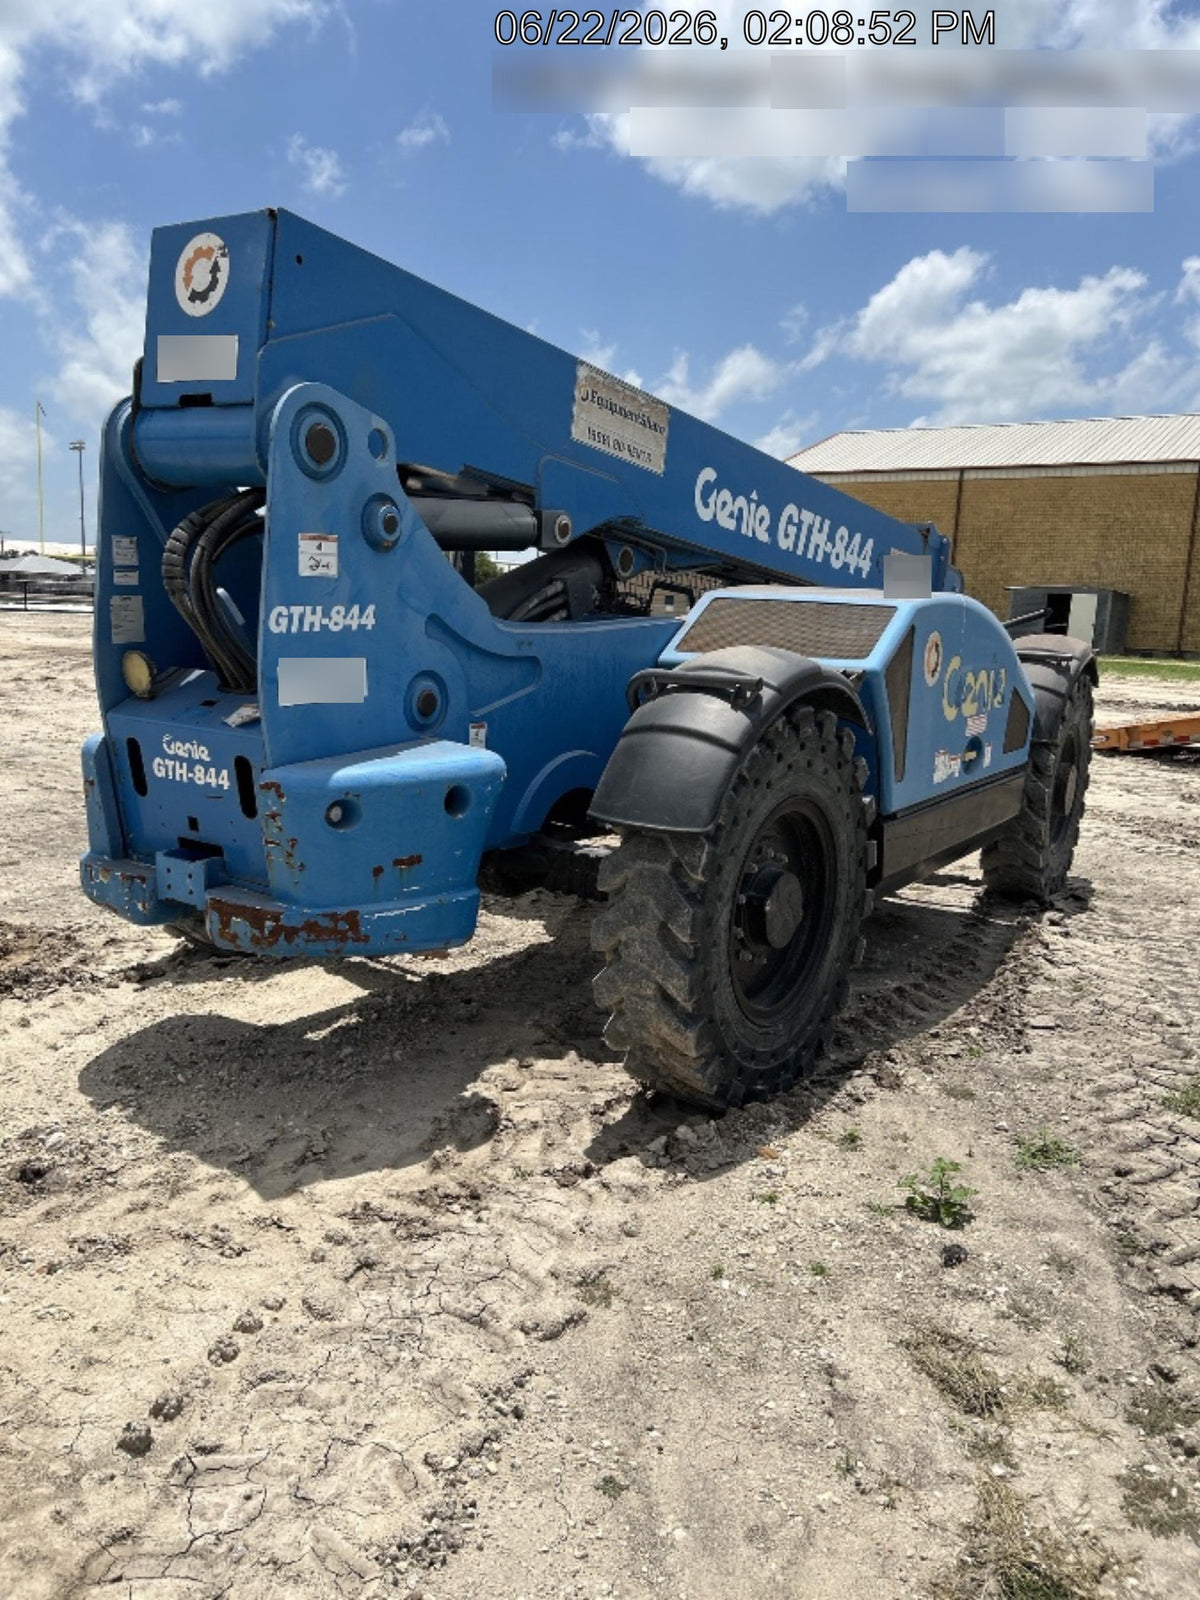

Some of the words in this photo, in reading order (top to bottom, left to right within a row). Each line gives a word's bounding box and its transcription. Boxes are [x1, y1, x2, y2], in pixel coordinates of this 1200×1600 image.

[694, 467, 771, 544] Genie
[777, 503, 875, 579] GTH-844
[268, 604, 377, 634] GTH-844
[161, 733, 212, 763] Genie
[152, 756, 231, 790] GTH-844
